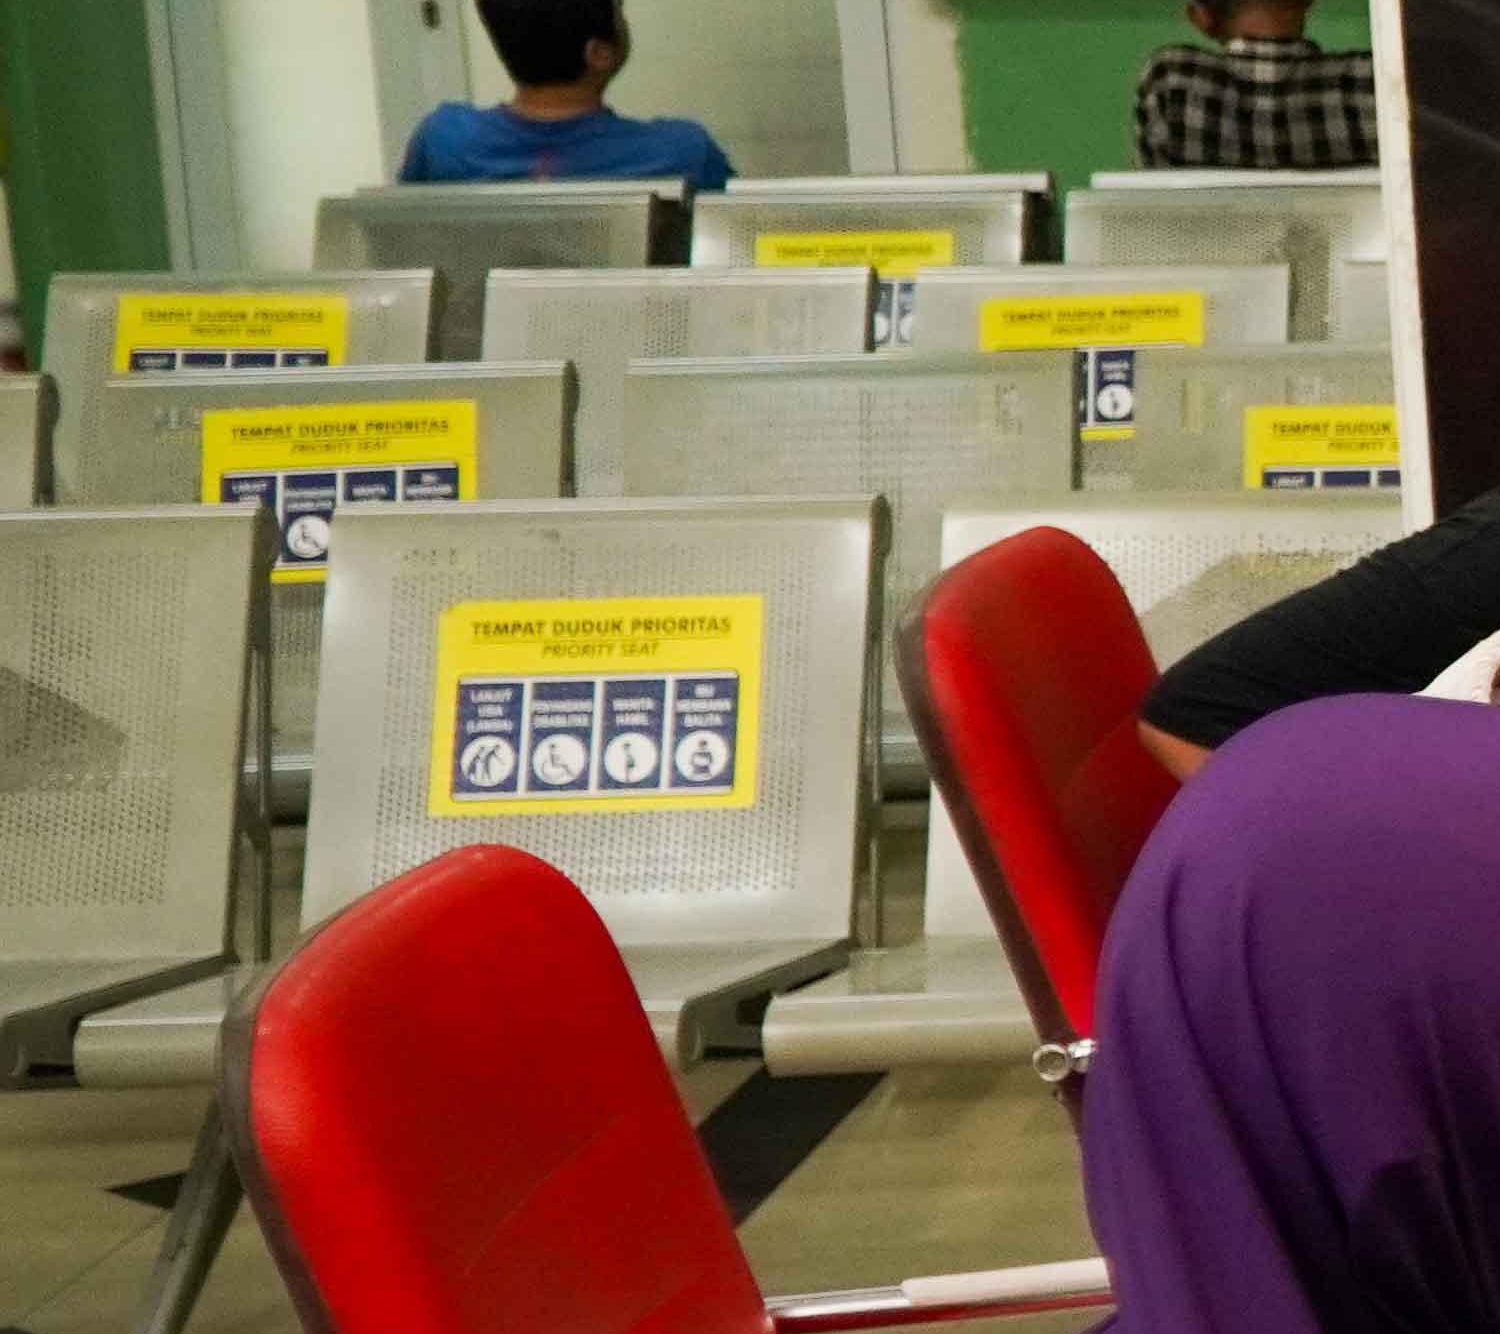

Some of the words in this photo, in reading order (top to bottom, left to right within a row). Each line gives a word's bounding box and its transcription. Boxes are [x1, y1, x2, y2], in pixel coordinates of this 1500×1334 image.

[232, 424, 293, 438] TEMPAT
[299, 422, 357, 436] DUDUK
[365, 419, 449, 434] PRIORITAS
[1272, 421, 1329, 435] TEMPAT
[471, 620, 547, 637] TEMPAT
[552, 619, 623, 637] DUDUK
[631, 616, 732, 635] PRIORITAS
[541, 643, 615, 660] PRIORITY
[621, 642, 660, 657] SEAT
